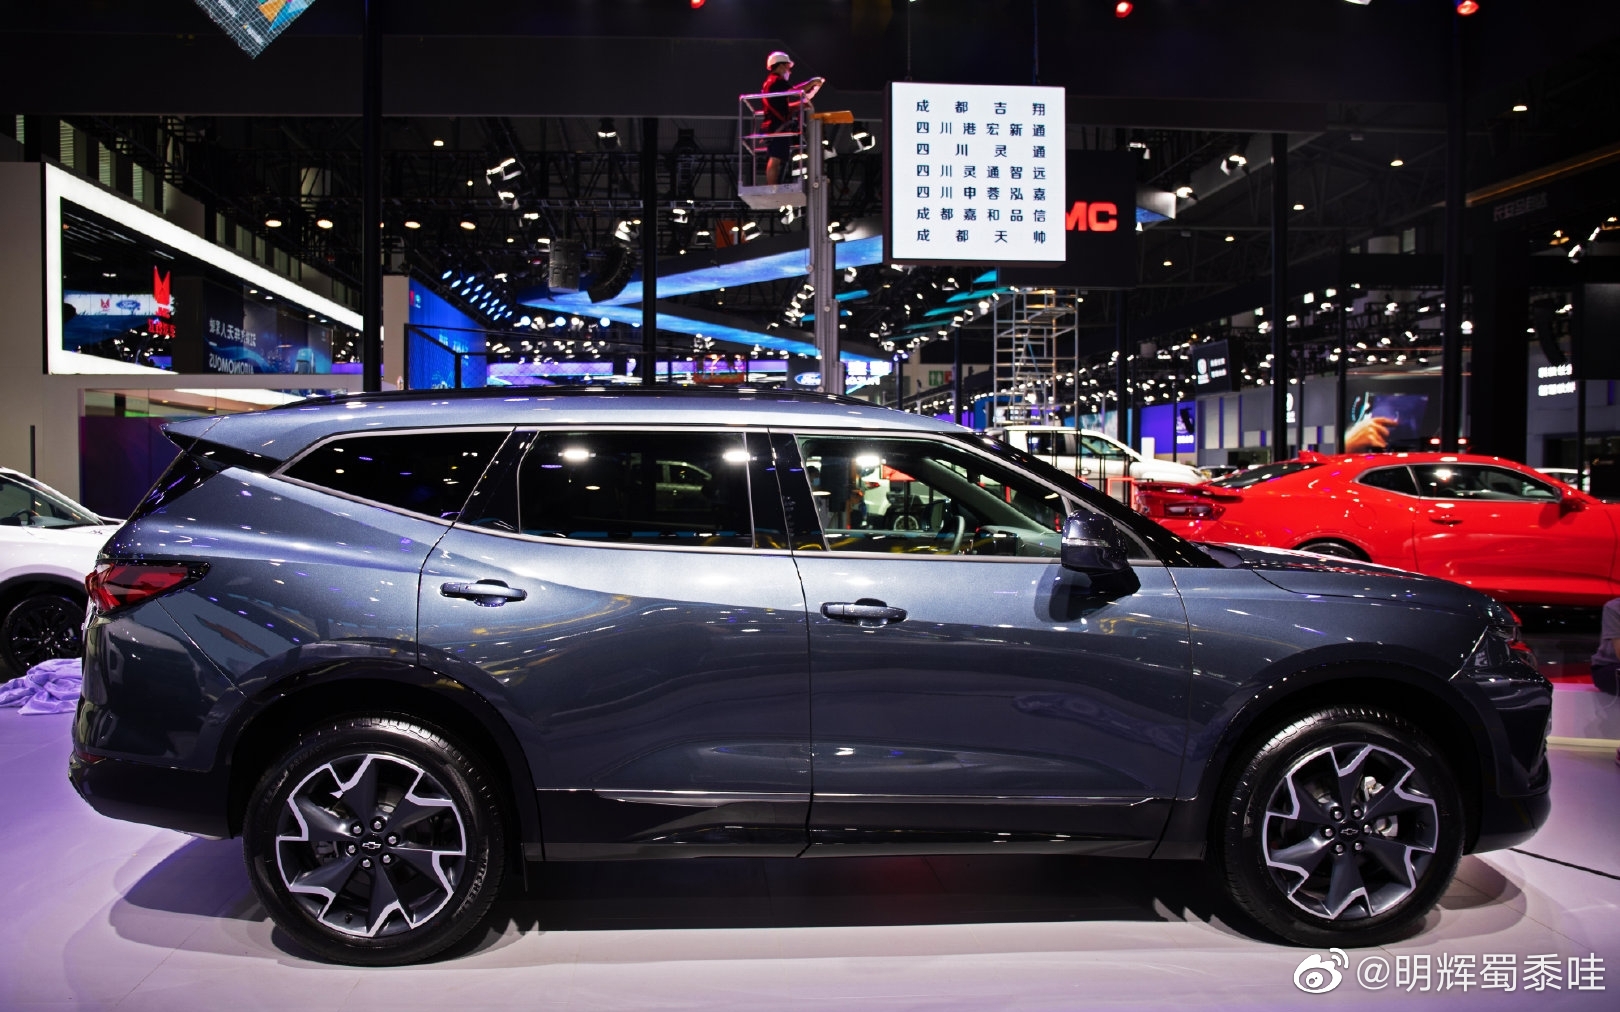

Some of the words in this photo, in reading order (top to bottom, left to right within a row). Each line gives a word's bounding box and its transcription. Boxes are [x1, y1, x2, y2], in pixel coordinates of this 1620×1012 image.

[916, 99, 1046, 116] 成都吉翔
[916, 121, 1046, 137] 四川港宏新通
[916, 143, 1046, 158] 四川灵通
[916, 164, 1046, 179] 四川灵通智远
[916, 186, 1046, 201] 四川申蓉泓嘉
[916, 206, 1046, 223] 成都嘉和品信
[1065, 201, 1118, 232] MC
[916, 228, 1046, 244] 成都天帅
